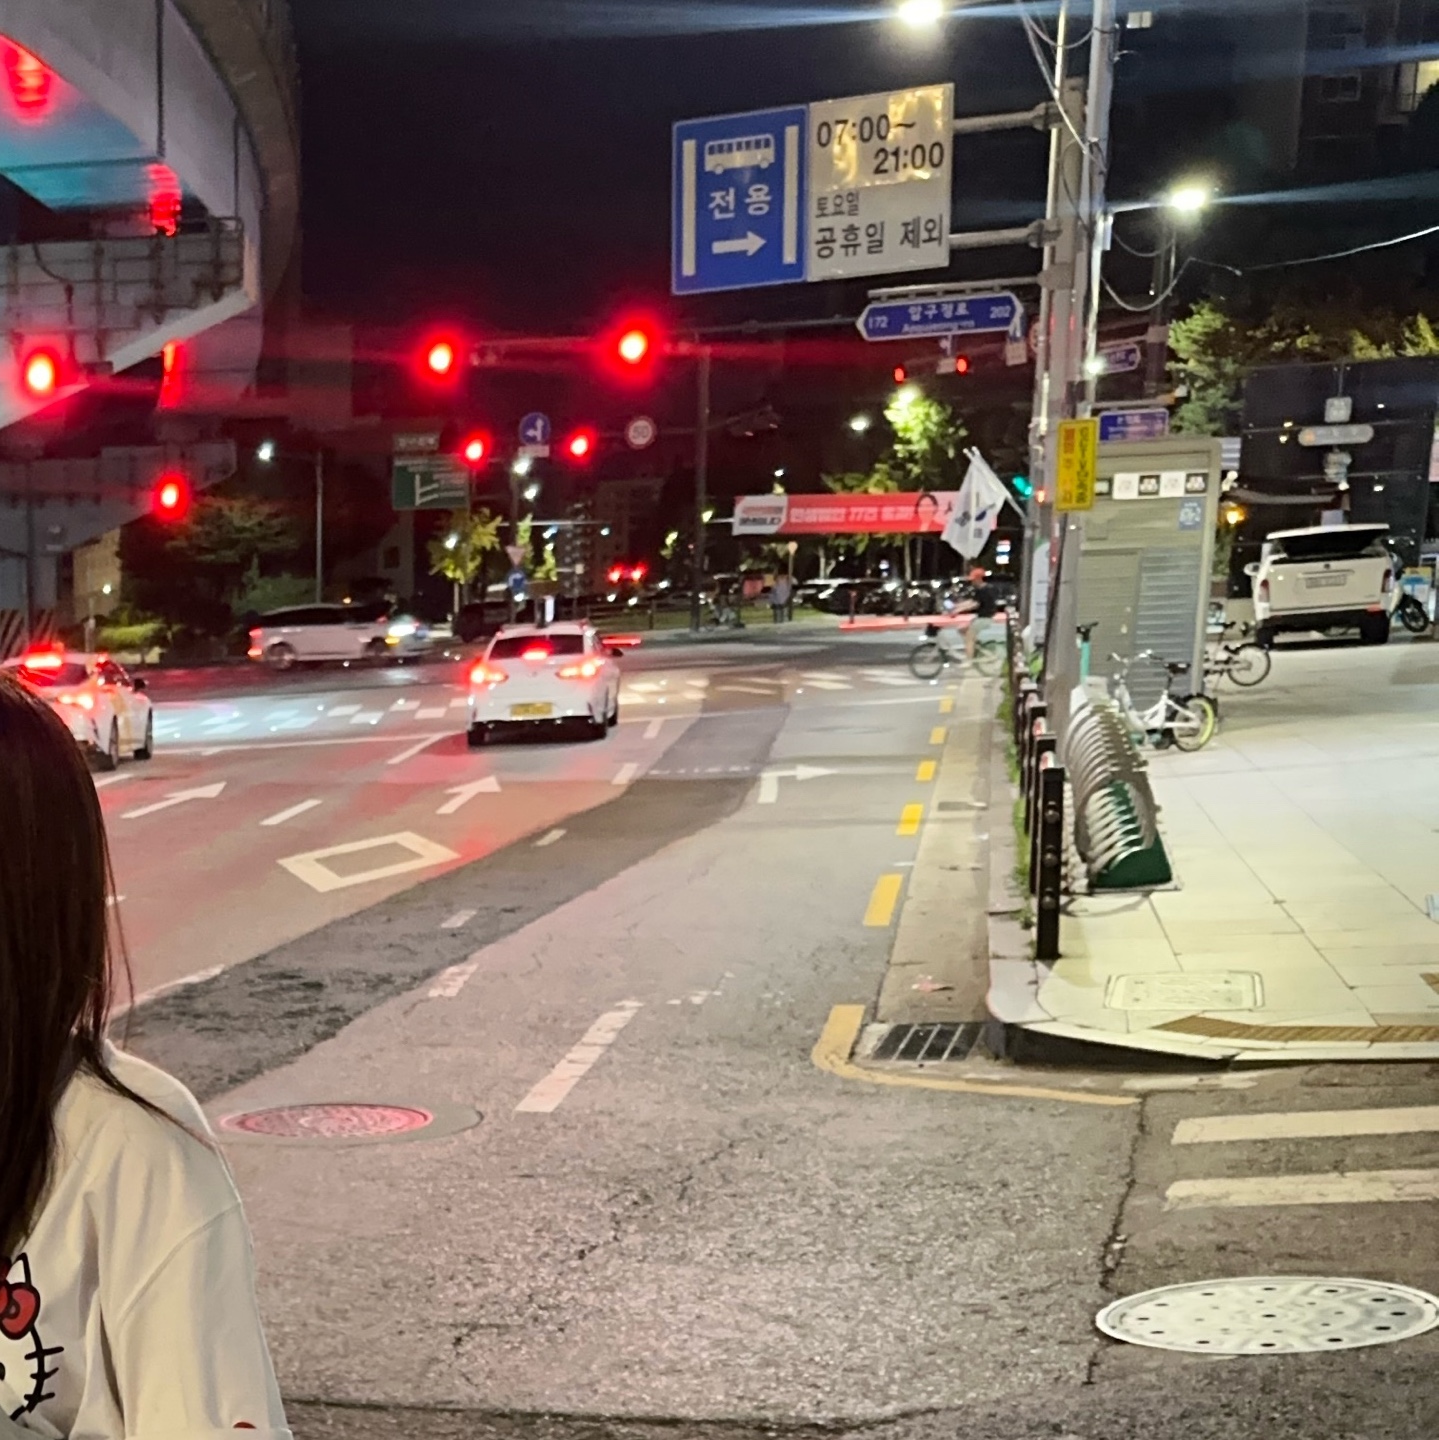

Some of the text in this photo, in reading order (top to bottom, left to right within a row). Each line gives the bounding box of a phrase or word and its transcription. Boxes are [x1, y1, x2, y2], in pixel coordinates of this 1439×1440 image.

[816, 114, 916, 147] 07:00~
[873, 142, 945, 175] 21:00
[815, 192, 860, 218] 토요일
[815, 214, 944, 259] 공휴일 제외
